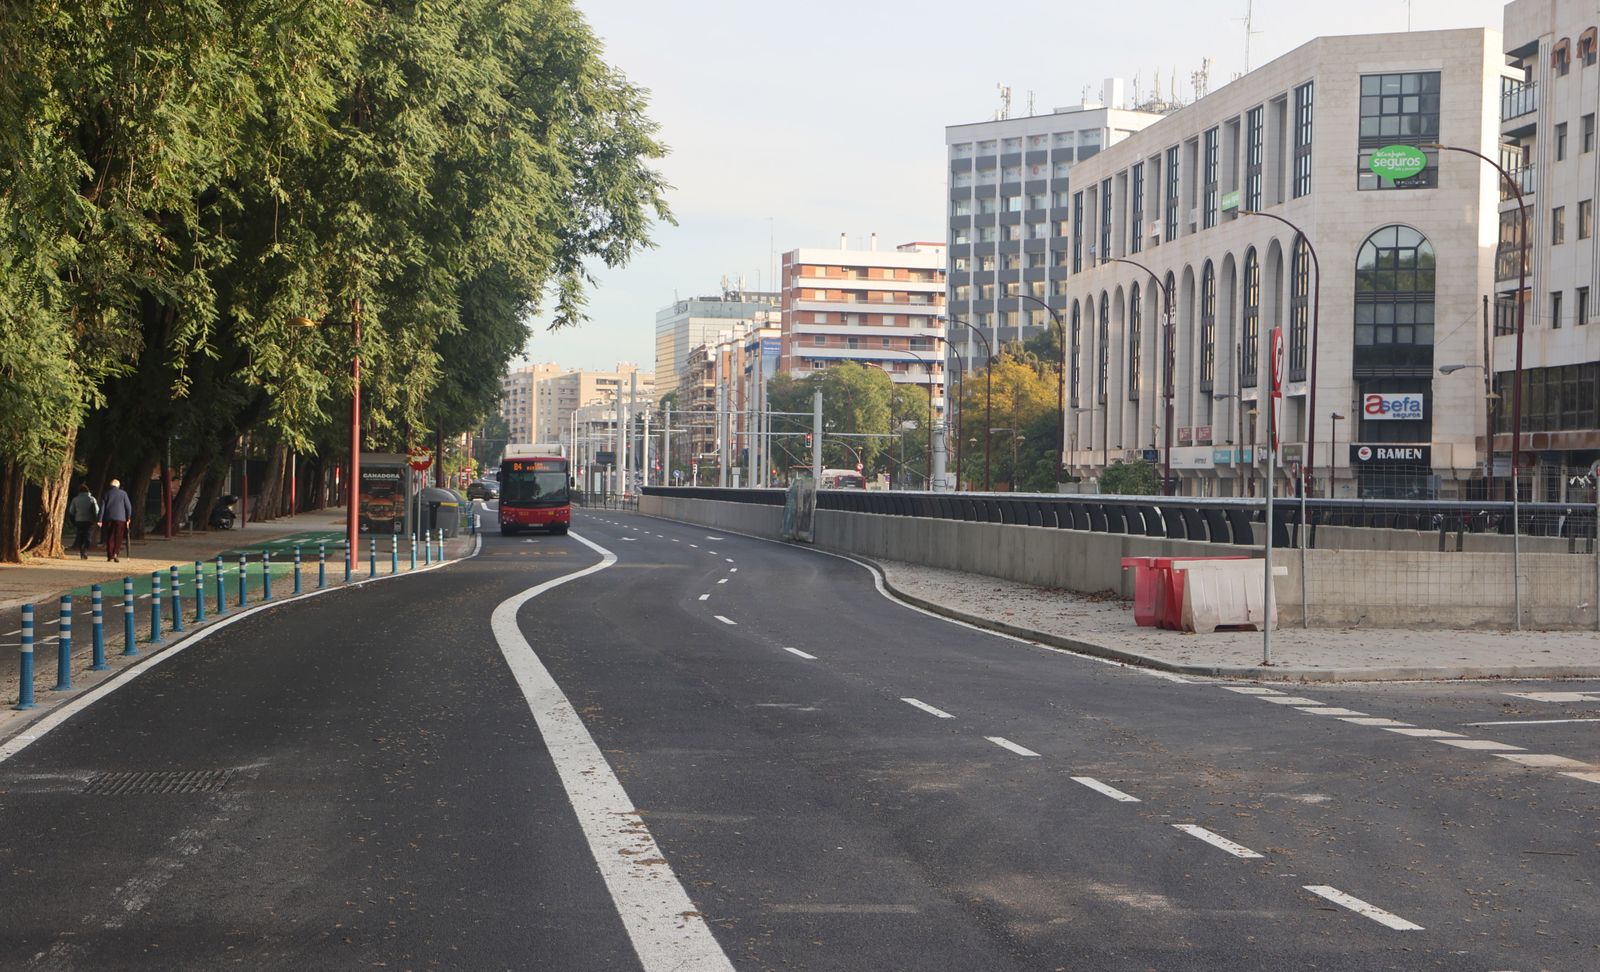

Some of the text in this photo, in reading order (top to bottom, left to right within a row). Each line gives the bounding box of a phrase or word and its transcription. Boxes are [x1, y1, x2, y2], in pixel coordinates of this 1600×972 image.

[1374, 157, 1421, 170] seguros
[1365, 394, 1421, 415] asefa
[1377, 448, 1422, 459] RAMEN
